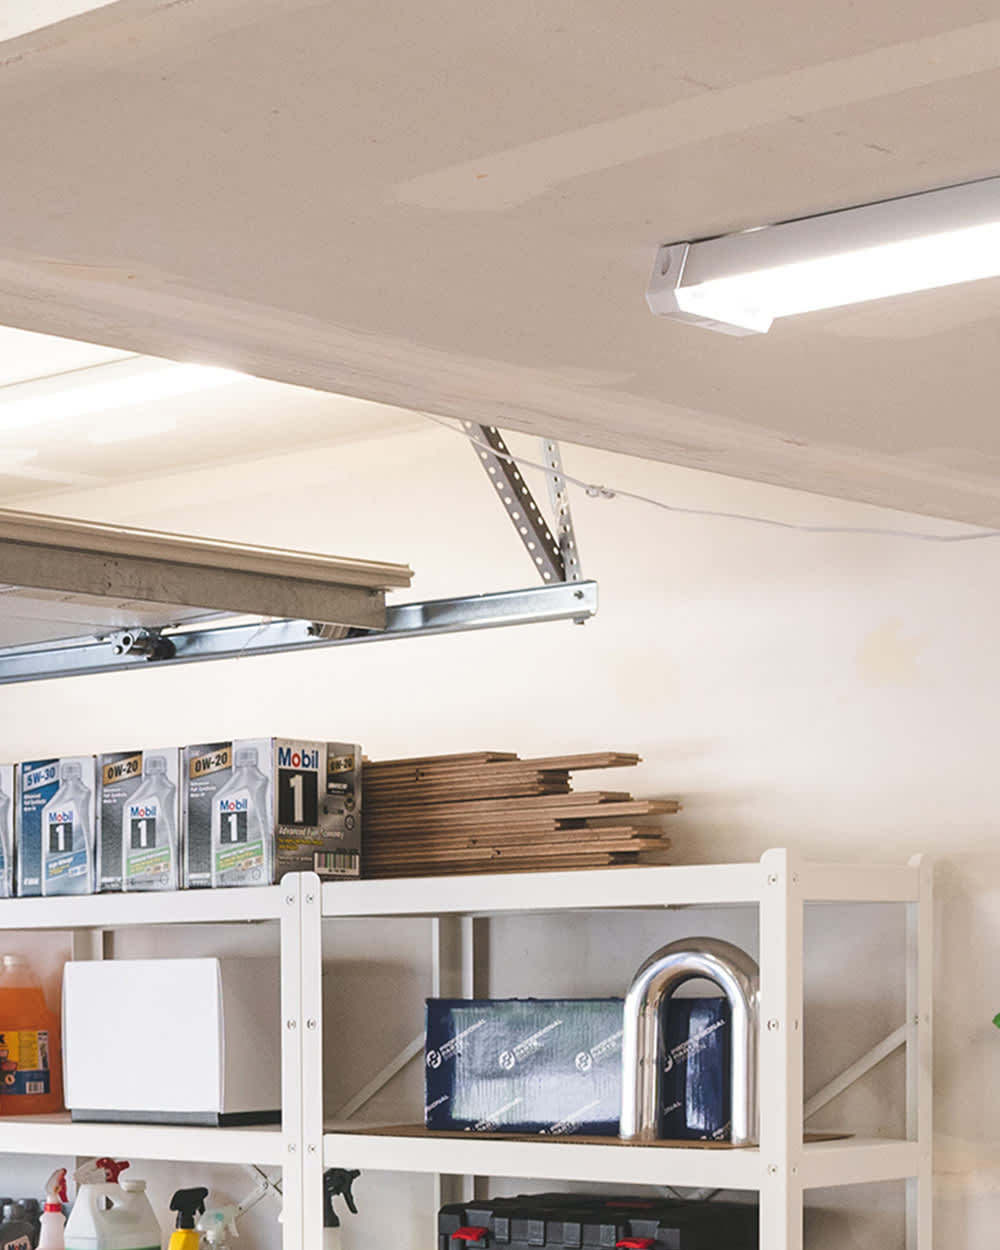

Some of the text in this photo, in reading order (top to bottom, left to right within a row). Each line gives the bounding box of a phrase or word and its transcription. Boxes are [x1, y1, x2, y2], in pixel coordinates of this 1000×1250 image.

[194, 752, 228, 772] 0W-20
[278, 747, 319, 769] Mobil
[27, 767, 56, 786] 5W-30
[107, 760, 138, 779] 0W-20
[219, 799, 248, 811] Mobil
[289, 774, 304, 823] 1
[49, 811, 73, 823] Mobil
[130, 806, 156, 818] Mobil
[55, 825, 65, 851] 1
[138, 820, 147, 847] 1
[228, 814, 238, 842] 1
